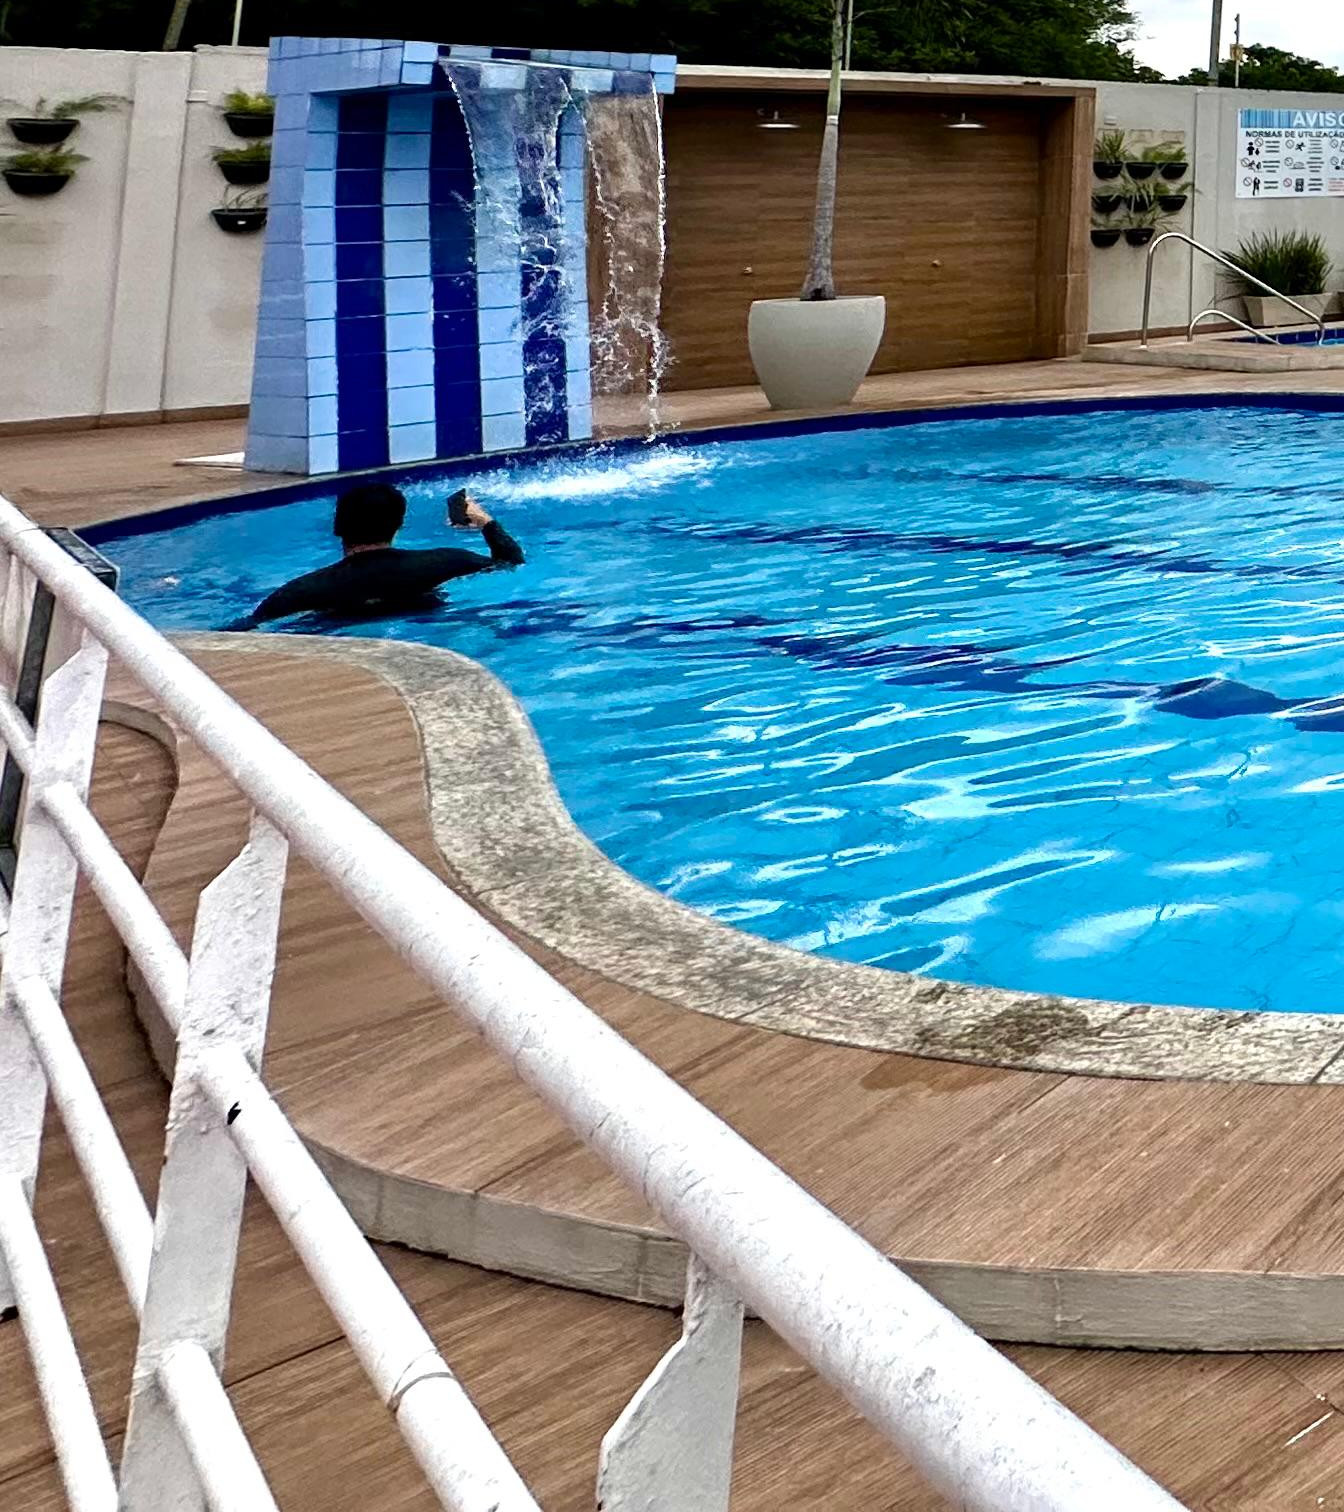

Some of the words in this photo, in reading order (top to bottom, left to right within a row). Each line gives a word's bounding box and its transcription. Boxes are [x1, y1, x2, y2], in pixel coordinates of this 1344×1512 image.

[1245, 130, 1282, 139] NORMAS
[1284, 130, 1296, 139] DE
[1297, 130, 1344, 139] UTILIZAÇÃO
